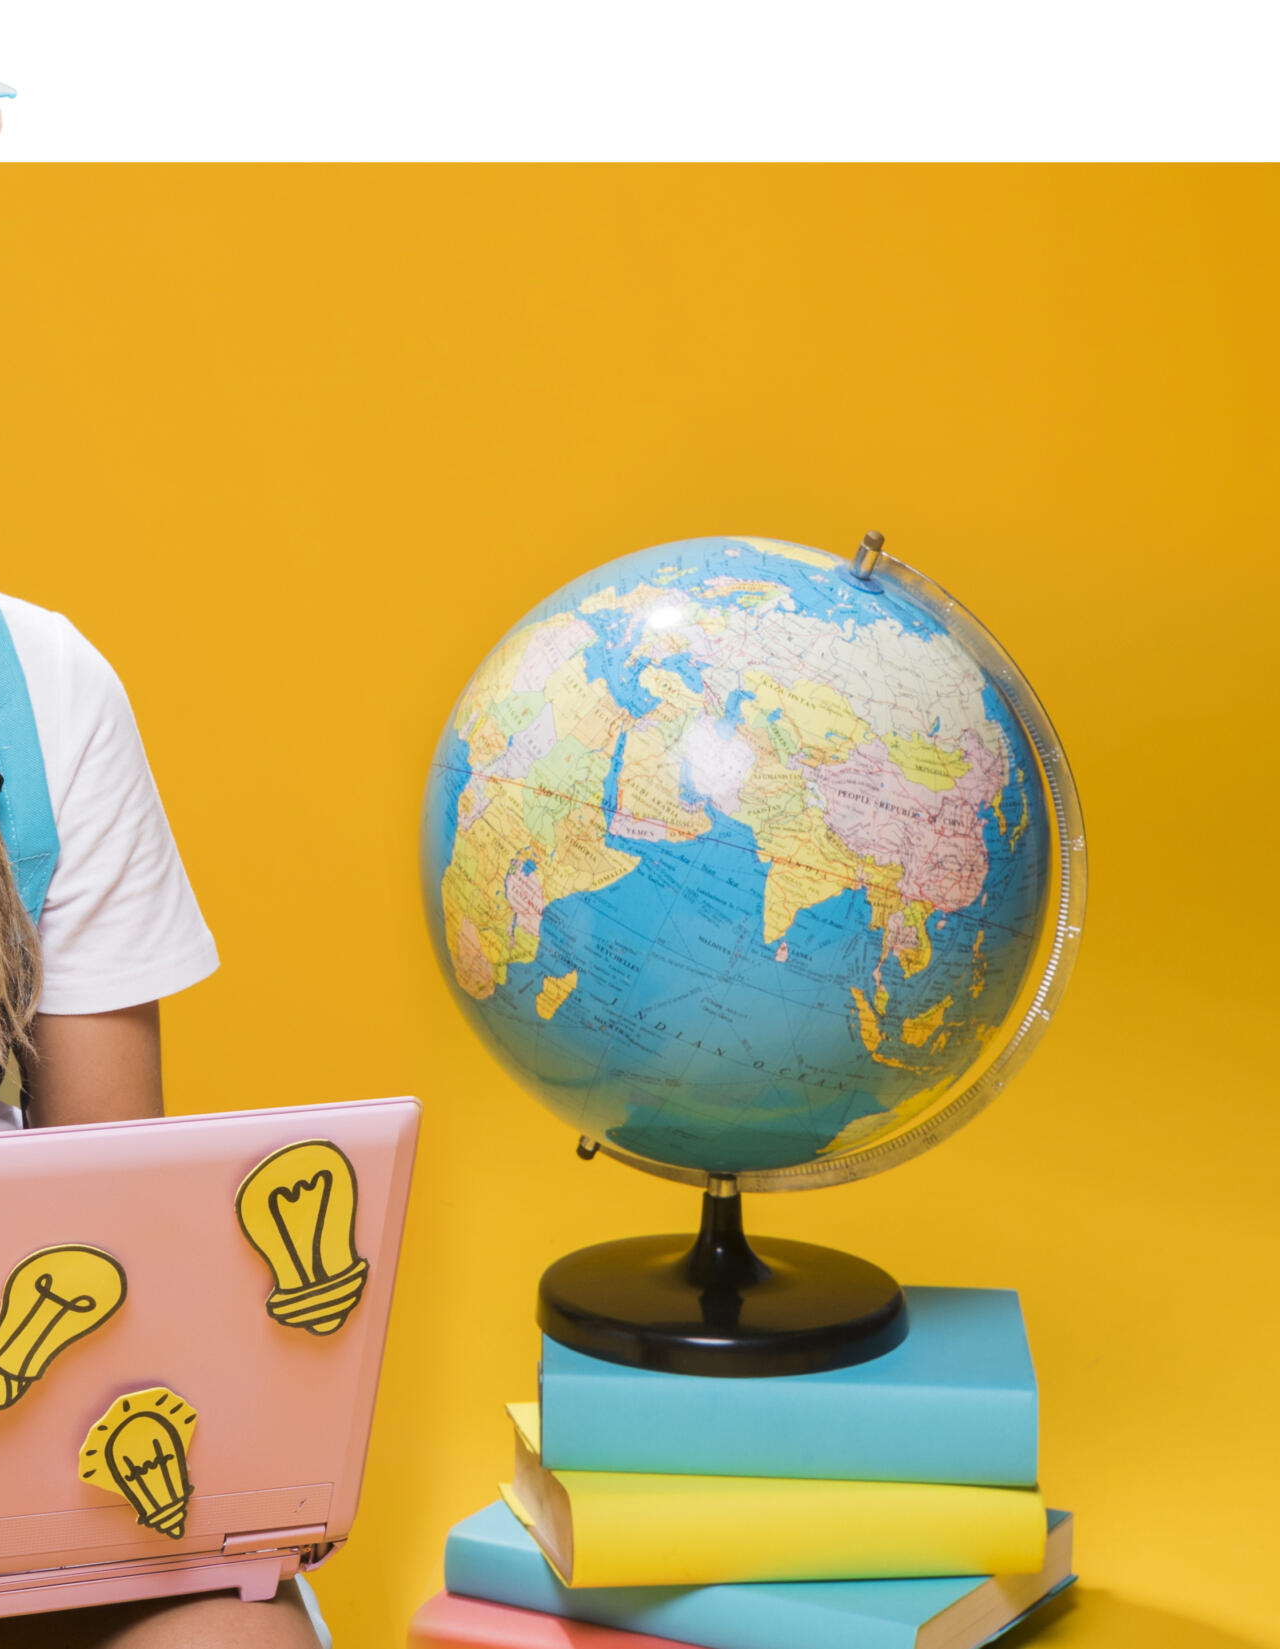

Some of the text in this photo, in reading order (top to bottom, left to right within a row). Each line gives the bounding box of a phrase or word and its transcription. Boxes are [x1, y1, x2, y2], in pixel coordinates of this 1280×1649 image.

[626, 827, 655, 838] YEMEN
[591, 866, 628, 888] SOMALIA
[596, 943, 640, 973] SEYCHELLES
[611, 997, 726, 1057] INDIAN
[753, 1060, 847, 1092] OCEAN
